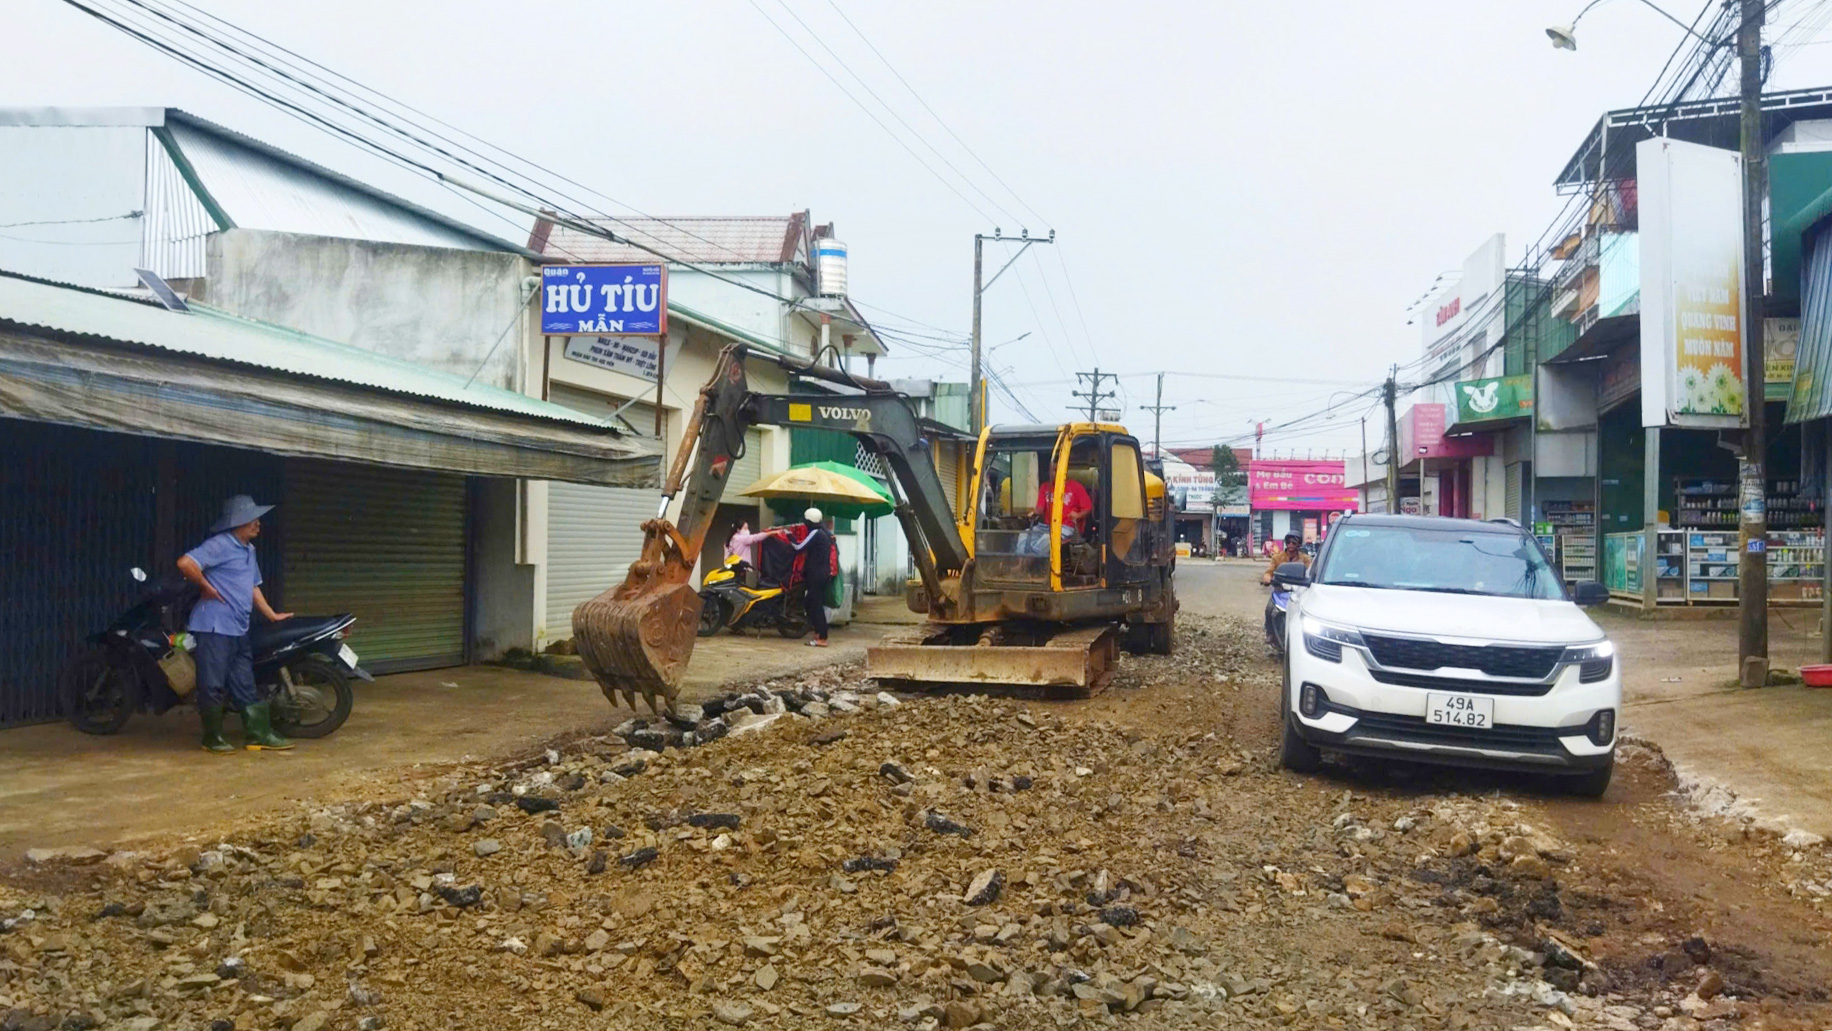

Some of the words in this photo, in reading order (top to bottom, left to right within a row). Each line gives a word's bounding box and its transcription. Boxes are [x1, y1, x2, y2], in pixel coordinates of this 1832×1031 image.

[546, 272, 593, 313] HỦ
[601, 275, 659, 313] TÍU
[1681, 311, 1712, 331] QUANG
[818, 406, 872, 421] VOLVO
[1446, 697, 1474, 711] 49A
[1433, 709, 1486, 727] 514.82
